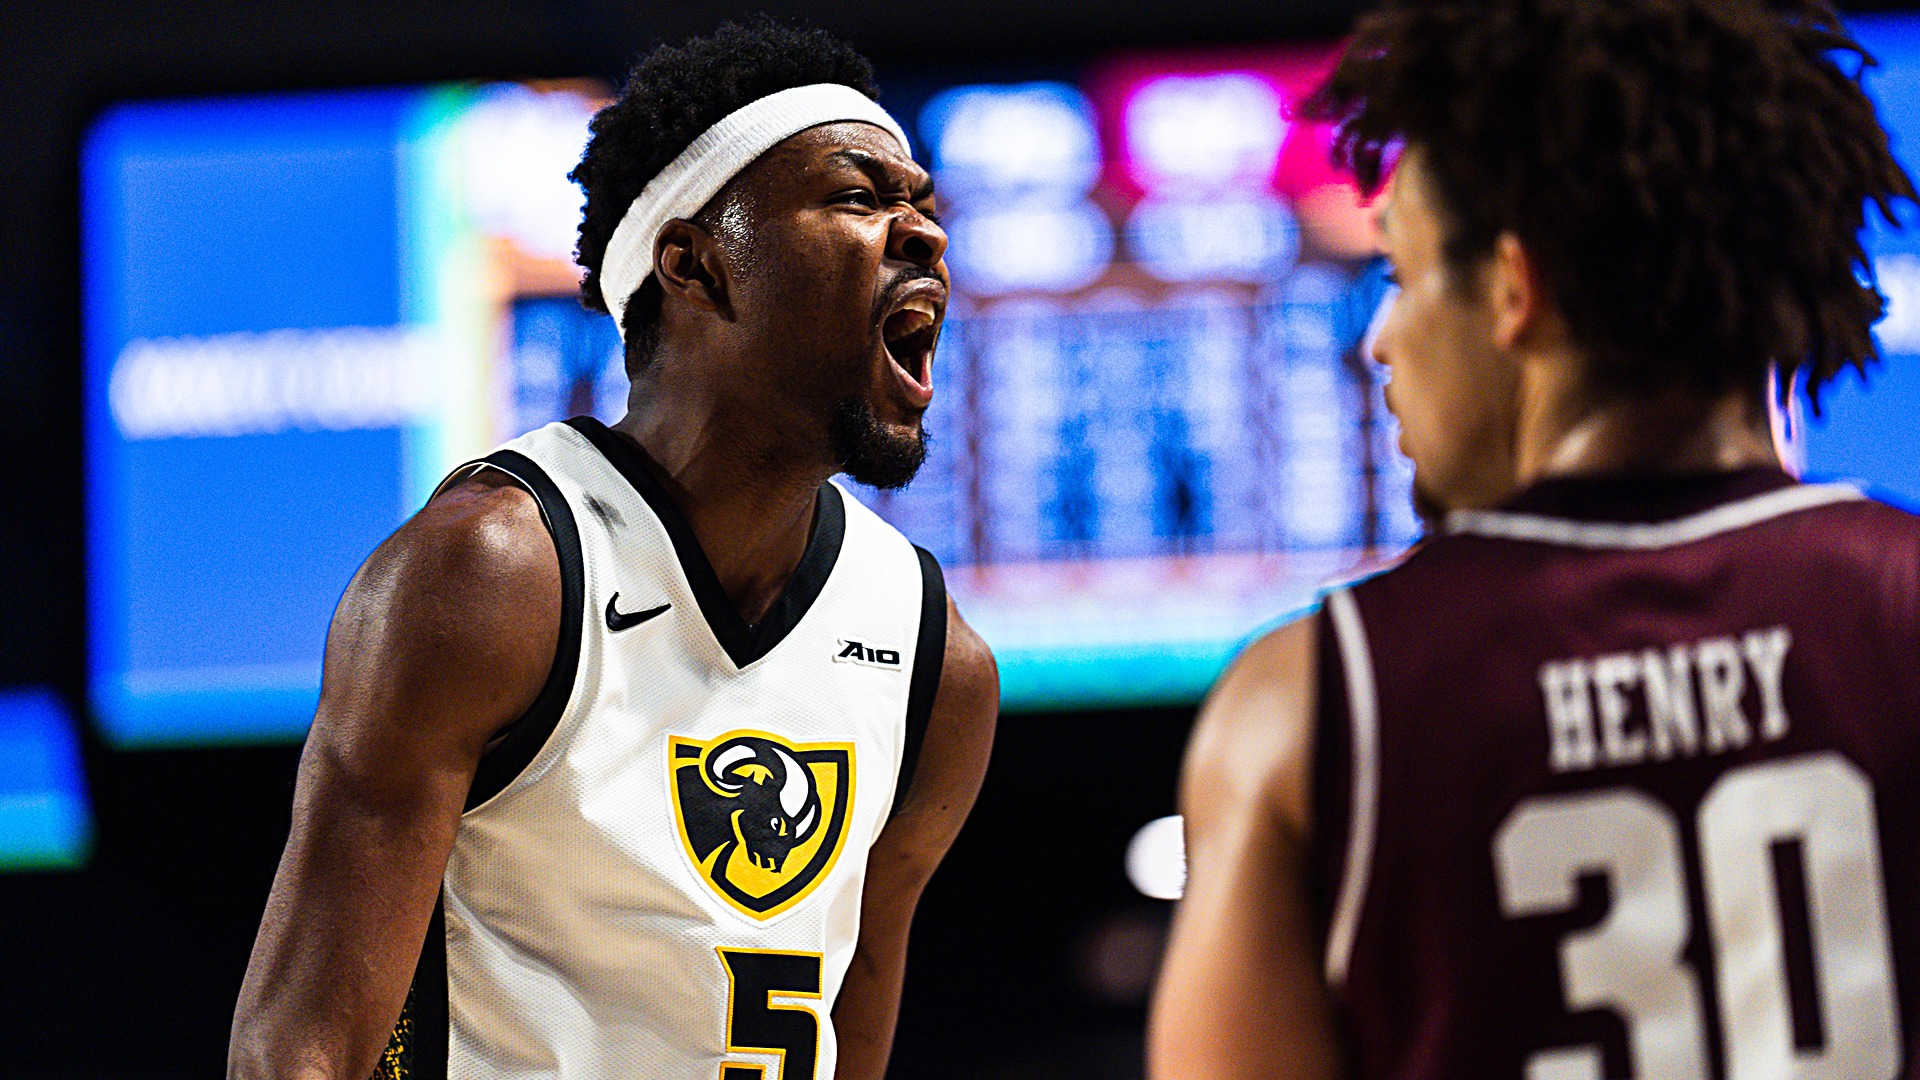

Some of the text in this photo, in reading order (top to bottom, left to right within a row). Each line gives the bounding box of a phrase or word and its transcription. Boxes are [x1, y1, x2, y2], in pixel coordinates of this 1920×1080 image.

[838, 640, 900, 665] A10
[1539, 627, 1791, 772] HENRY
[1491, 751, 1904, 1080] 30
[715, 946, 824, 1080] 5
